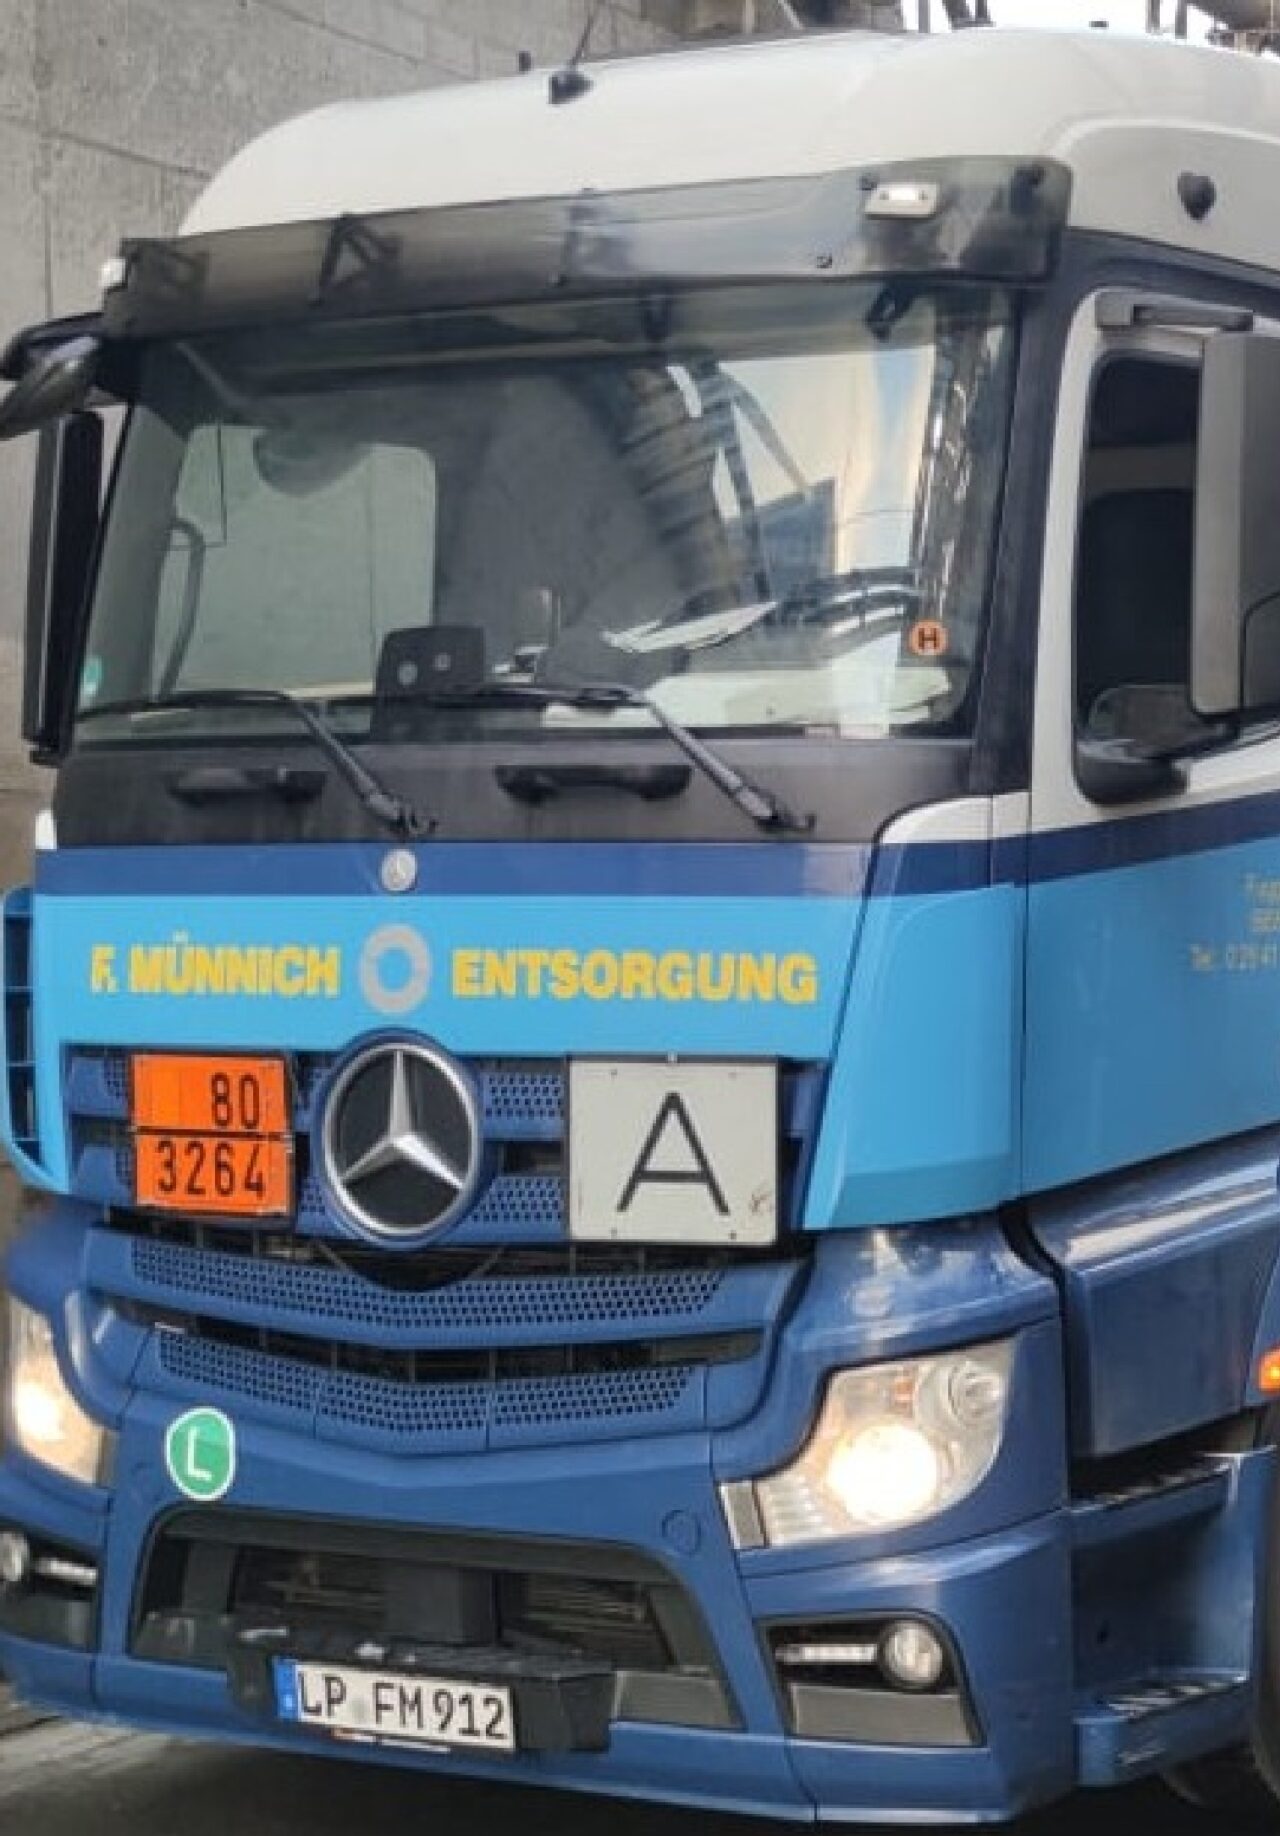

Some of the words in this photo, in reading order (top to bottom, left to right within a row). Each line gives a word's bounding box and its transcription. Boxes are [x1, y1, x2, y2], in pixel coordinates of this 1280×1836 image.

[918, 627, 938, 650] H
[91, 943, 118, 993] F.
[129, 930, 341, 997] MÜNNICH
[452, 948, 818, 1004] ENTSORGUNG
[210, 1072, 260, 1129] 80
[156, 1139, 265, 1199] 3264
[616, 1091, 731, 1216] A
[187, 1425, 213, 1482] L
[299, 1671, 346, 1718] LP
